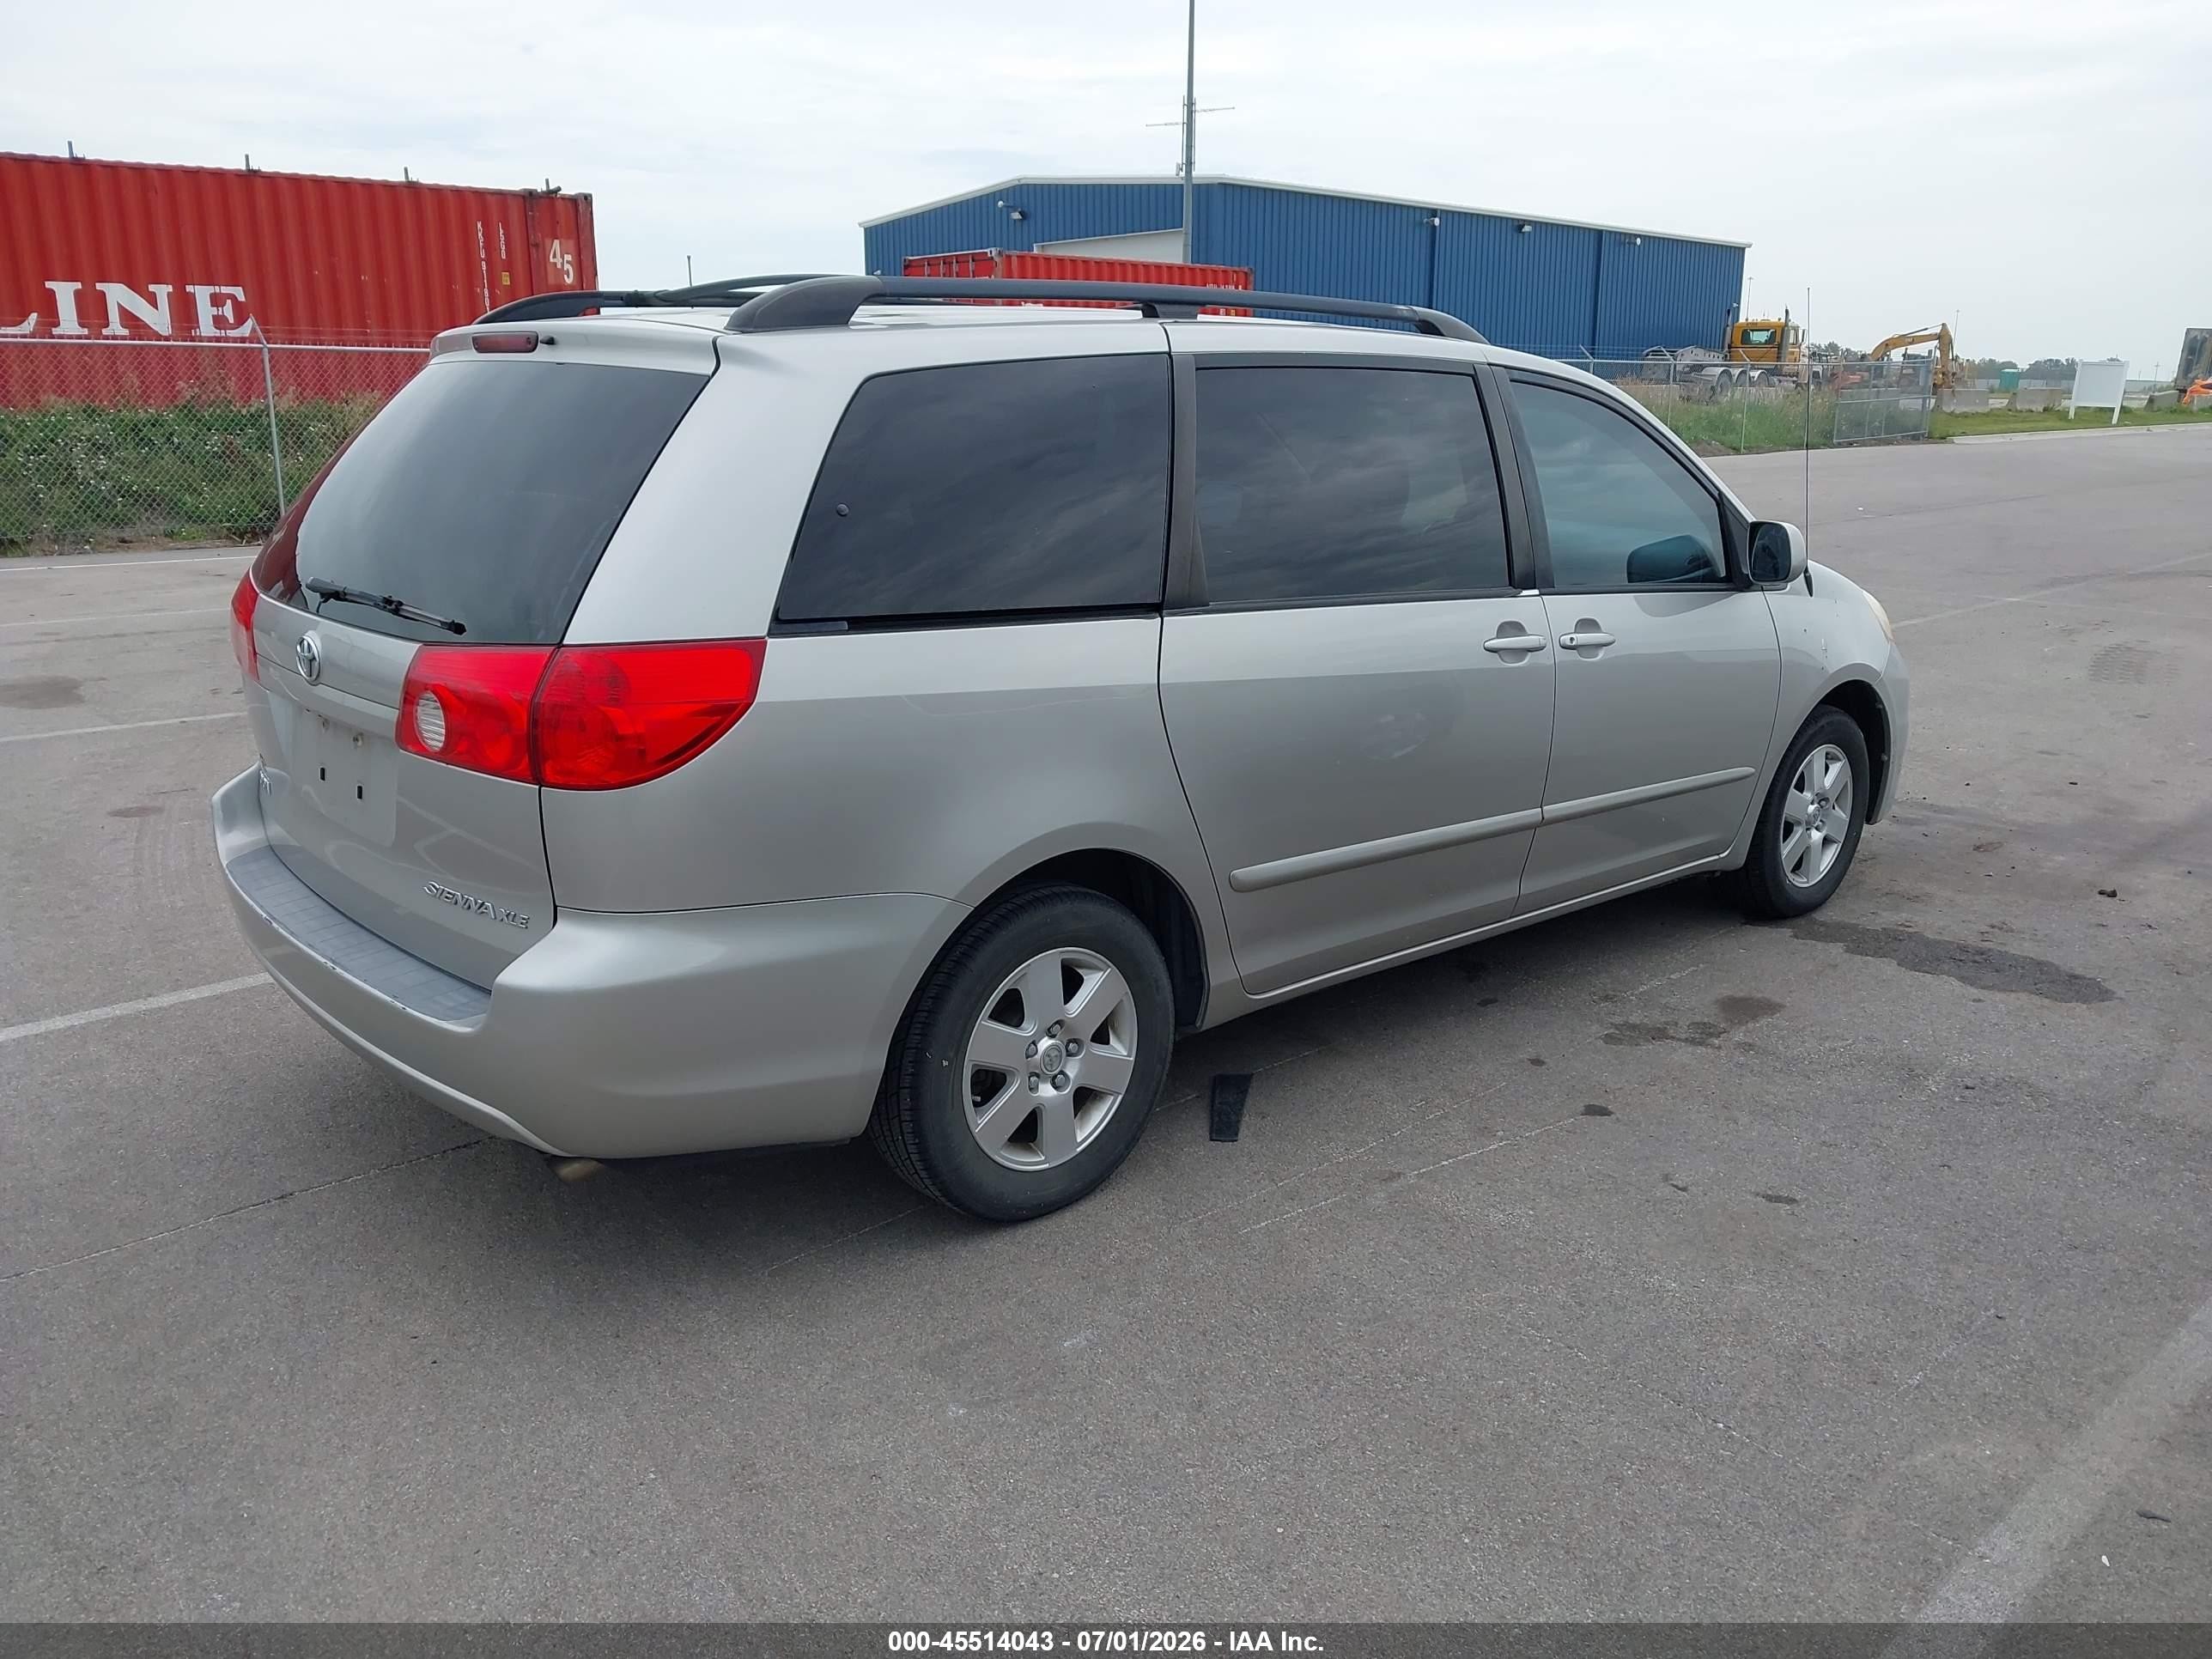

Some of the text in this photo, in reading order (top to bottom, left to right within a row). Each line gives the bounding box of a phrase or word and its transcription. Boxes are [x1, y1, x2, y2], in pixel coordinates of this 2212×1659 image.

[549, 239, 574, 285] 45
[422, 880, 530, 929] SIENNA XLE
